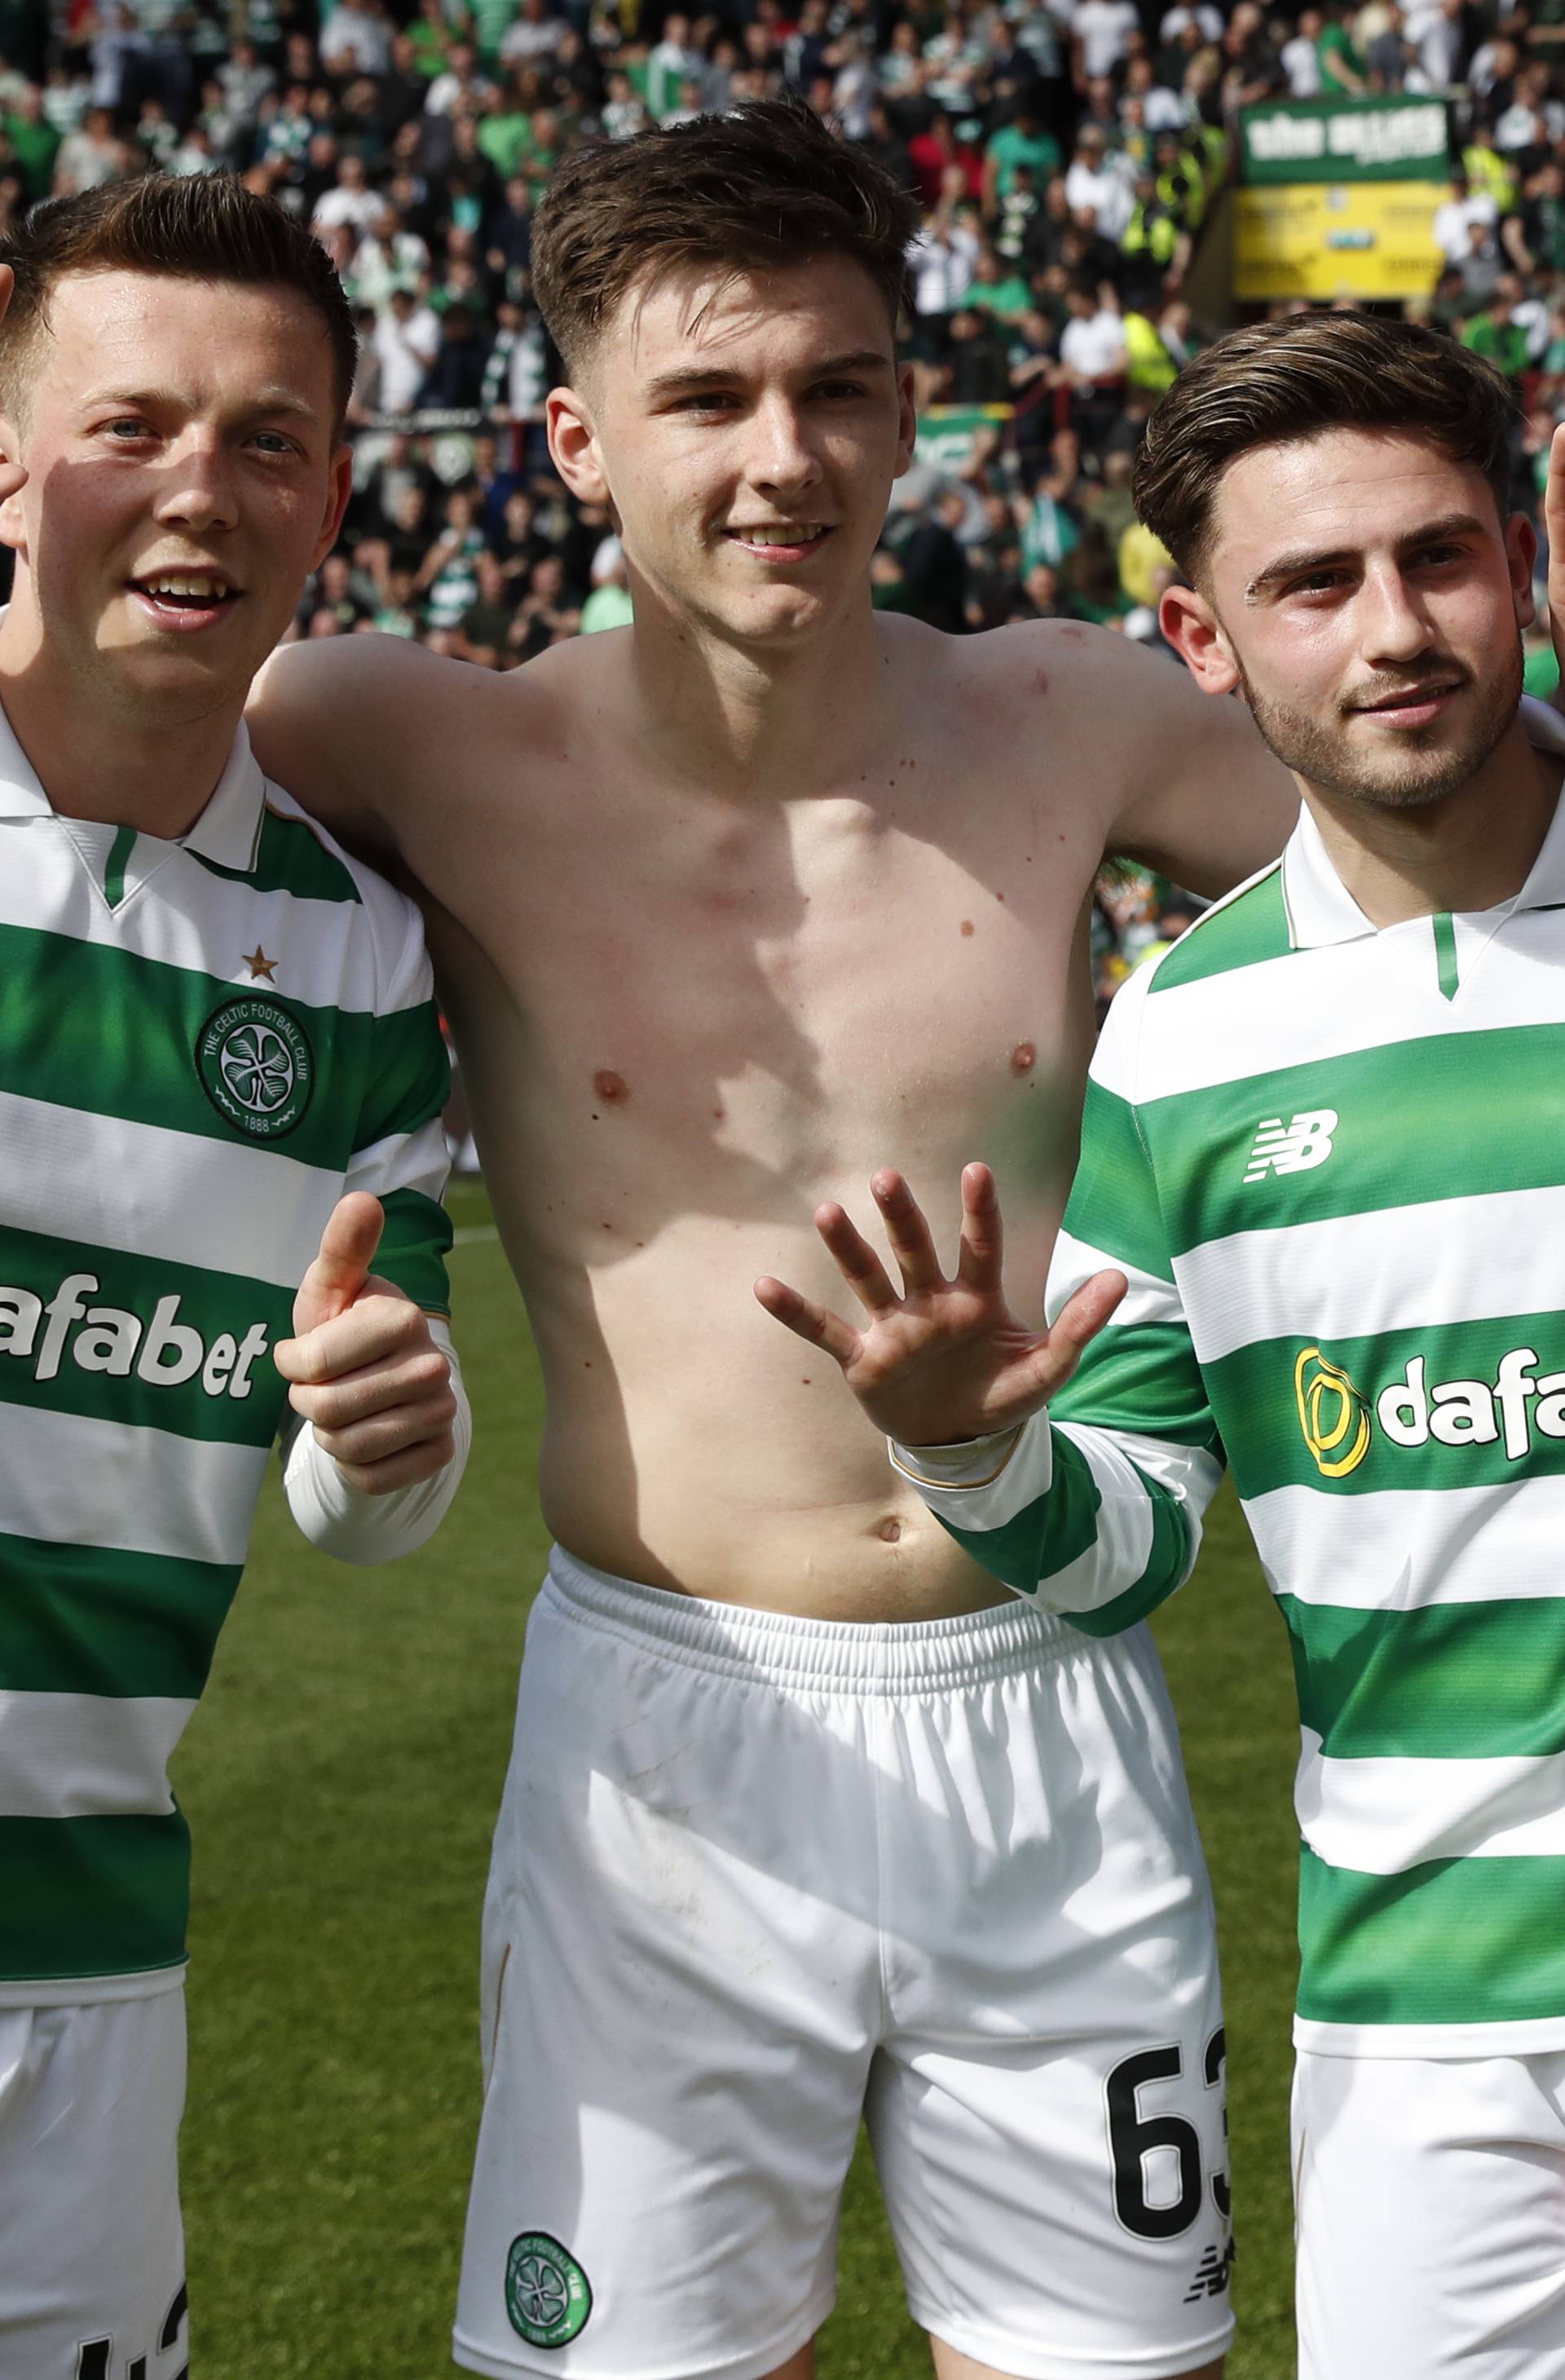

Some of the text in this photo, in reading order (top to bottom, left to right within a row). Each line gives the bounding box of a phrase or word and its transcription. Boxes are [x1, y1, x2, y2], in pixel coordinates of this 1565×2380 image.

[204, 1004, 308, 1080] THE CELTIC FOOTBALL CLUB
[244, 1115, 270, 1133] 1888
